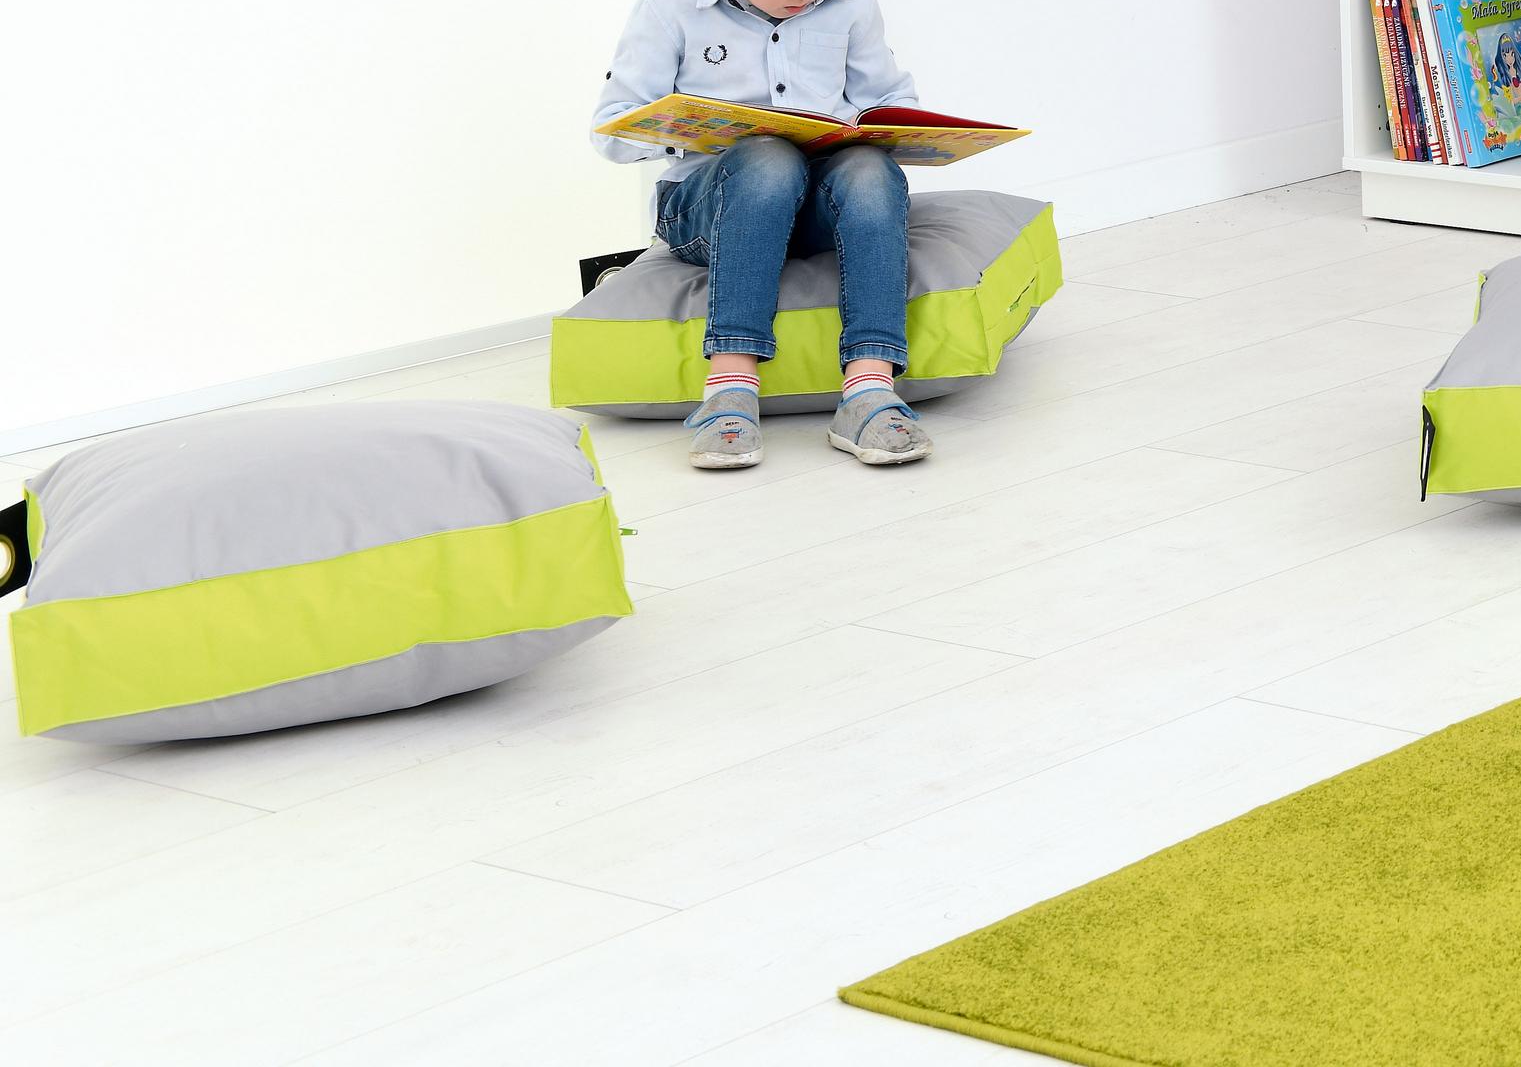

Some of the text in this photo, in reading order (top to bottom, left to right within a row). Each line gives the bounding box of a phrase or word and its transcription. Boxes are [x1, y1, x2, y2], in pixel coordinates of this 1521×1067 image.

[1386, 17, 1407, 108] ZAGADKI MATEMATYCZNE
[1393, 18, 1411, 88] ZAGADKI FIZYCZNE
